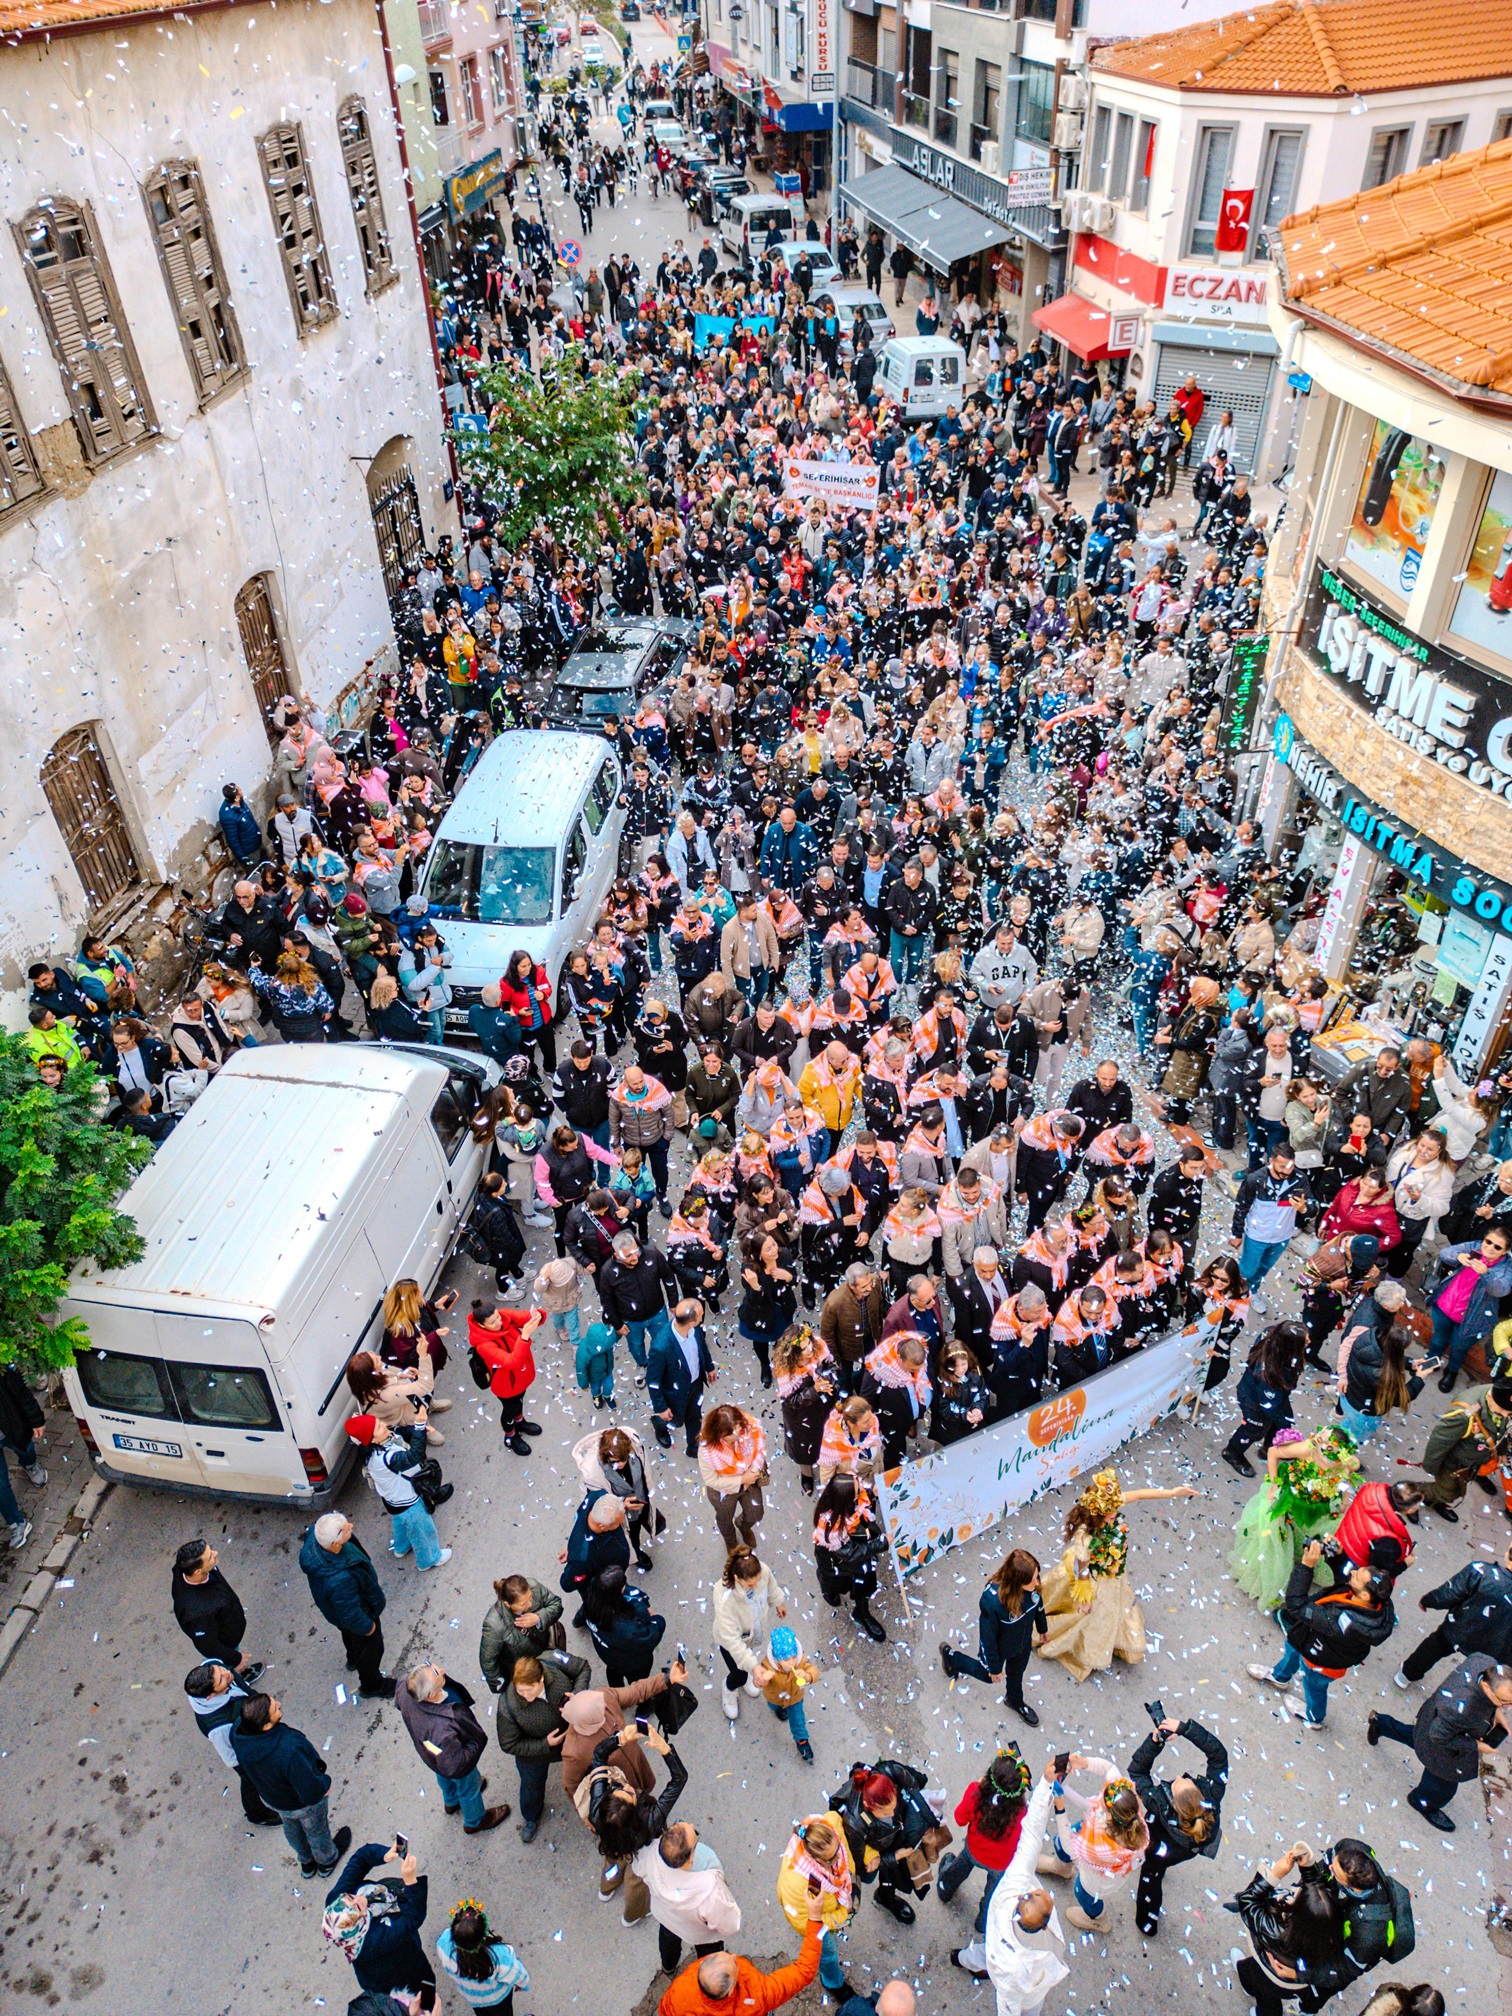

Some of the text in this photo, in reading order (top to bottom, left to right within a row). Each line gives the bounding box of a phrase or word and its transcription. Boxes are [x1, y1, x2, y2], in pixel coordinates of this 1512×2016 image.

[818, 32, 828, 71] KURSU
[911, 144, 954, 192] ASLAR
[1171, 272, 1267, 305] ECZAN
[1118, 323, 1134, 343] E
[833, 490, 875, 501] BAŞKANLIĞI
[1321, 569, 1357, 614] WEBER
[1317, 603, 1478, 749] İŞİTME
[1286, 741, 1340, 811] NEHİR
[1437, 747, 1468, 773] ve
[1342, 797, 1436, 885] ISITMA
[1040, 1397, 1078, 1428] 24.
[121, 1437, 134, 1448] 35
[165, 1444, 178, 1455] 15
[997, 1407, 1118, 1481] Mandalina
